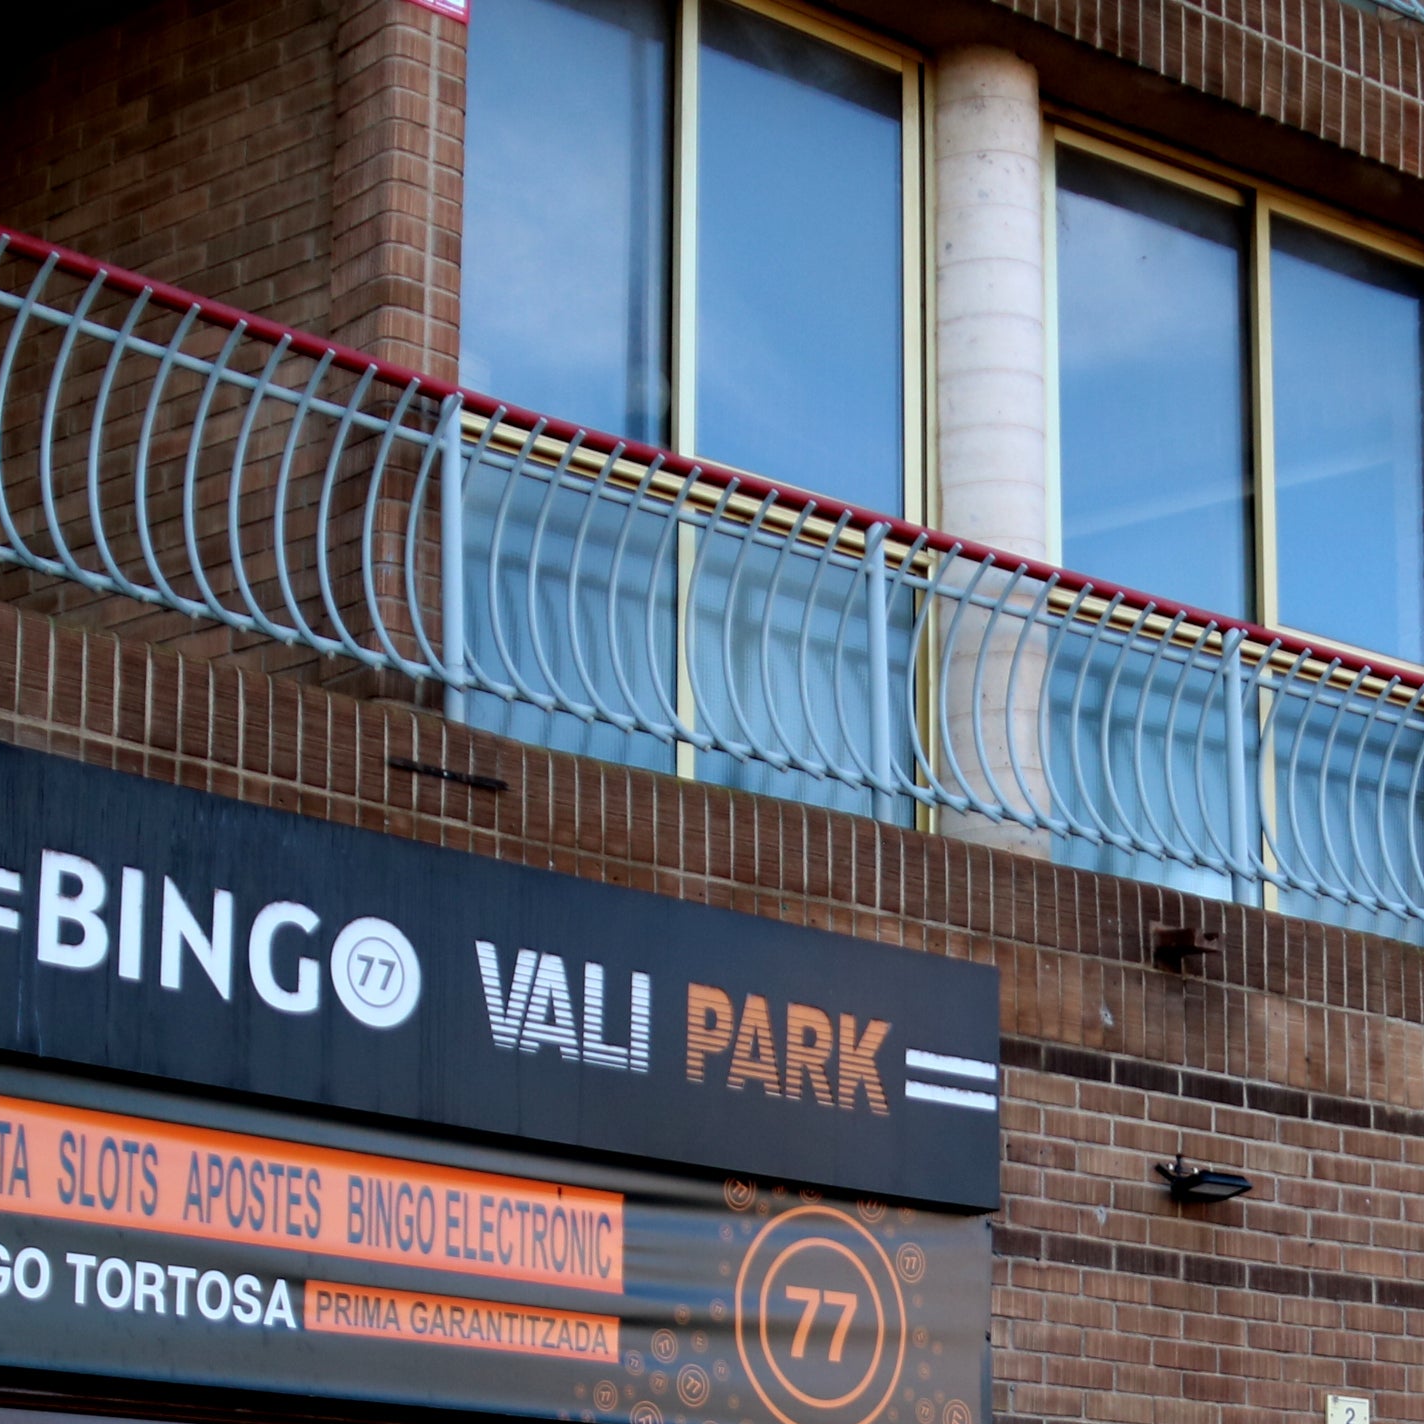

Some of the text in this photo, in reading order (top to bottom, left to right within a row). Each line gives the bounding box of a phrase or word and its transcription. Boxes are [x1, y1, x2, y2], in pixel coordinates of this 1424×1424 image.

[36, 848, 892, 1116] BINGO VALI PARK
[355, 954, 398, 992] 77
[56, 1128, 160, 1217] SLOTS
[181, 1149, 322, 1240] APOSTES
[346, 1174, 436, 1255] BINGO
[65, 1252, 297, 1330] TORTOSA
[315, 1289, 401, 1332] PRIMA
[408, 1300, 610, 1356] GARANTITZADA
[784, 1285, 859, 1363] 77
